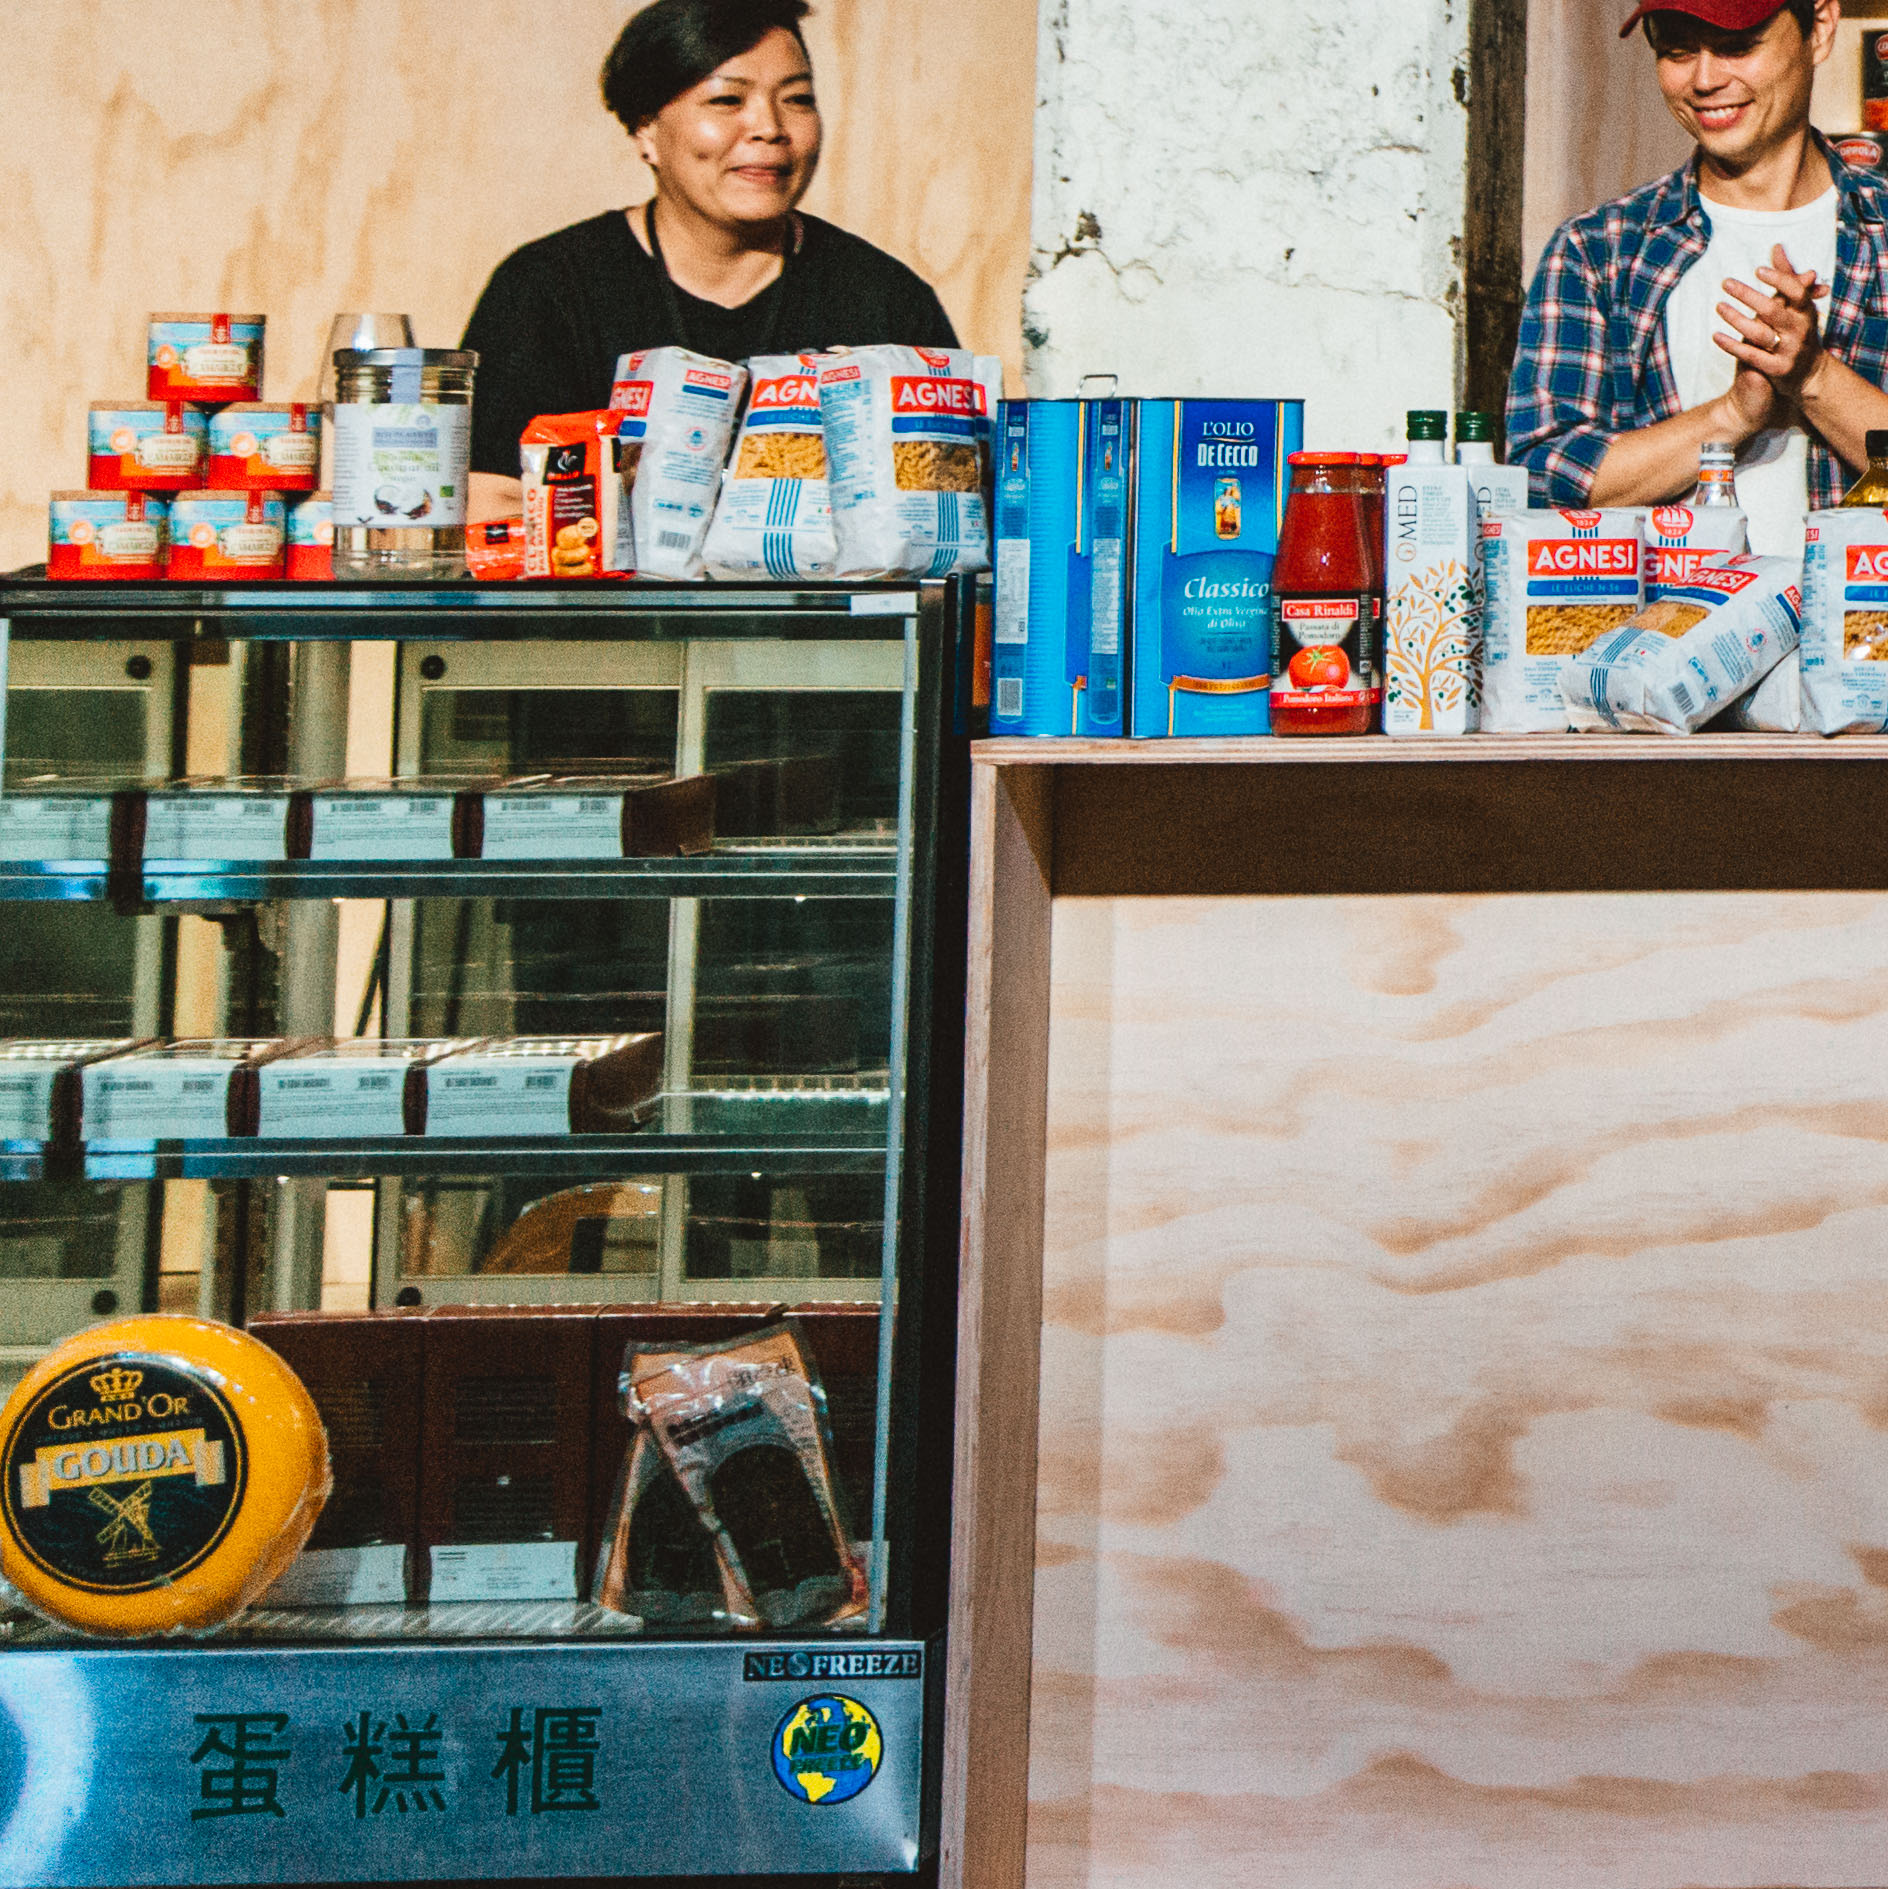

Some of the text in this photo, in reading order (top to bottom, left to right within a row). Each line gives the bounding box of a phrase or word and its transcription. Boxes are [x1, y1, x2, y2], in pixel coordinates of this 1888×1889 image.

[757, 379, 818, 404] AGN
[1202, 421, 1255, 437] L'OLIO
[1535, 544, 1634, 570] AGNESI
[1184, 576, 1270, 598] Classico
[1286, 603, 1354, 616] Casa Rinaldi
[54, 1439, 191, 1481] GOUDA
[790, 1721, 868, 1756] NEO
[189, 1706, 602, 1823] 蛋糕櫃
